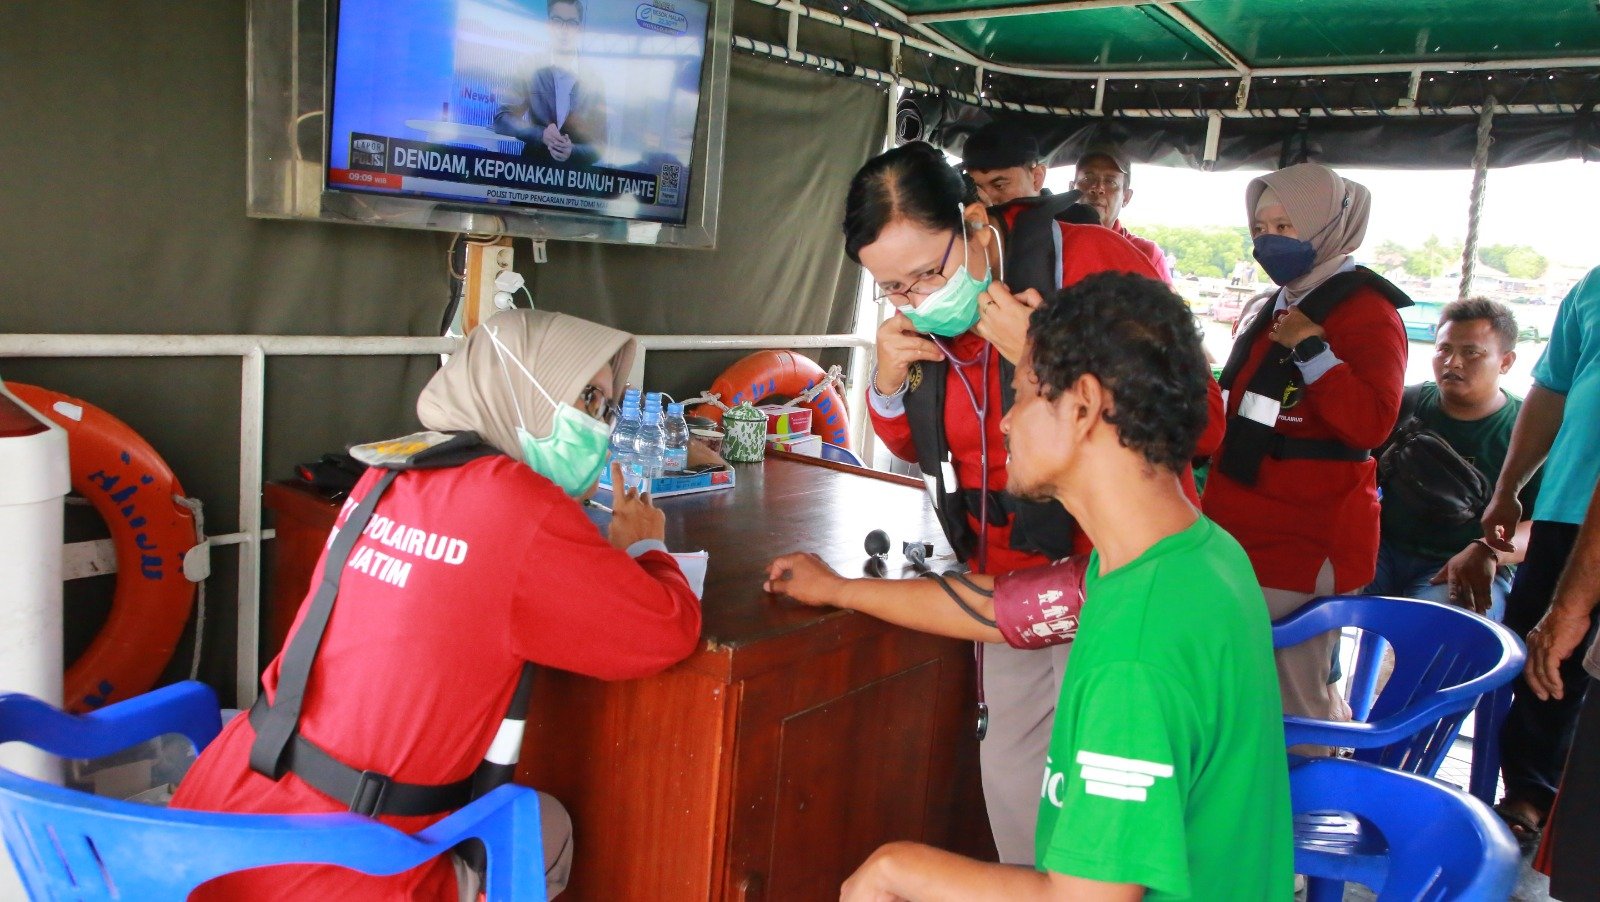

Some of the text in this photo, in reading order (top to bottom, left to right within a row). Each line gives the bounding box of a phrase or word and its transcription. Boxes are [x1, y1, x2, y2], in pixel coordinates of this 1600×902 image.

[356, 140, 382, 150] LAPOR
[352, 151, 384, 167] POLISI
[375, 176, 387, 184] WIB
[394, 146, 656, 198] DENDAM, KEPONAKAN BUNUH TANTE
[487, 189, 507, 199] POLISI
[509, 191, 529, 201] TUTUP
[530, 194, 565, 205] PENCARIAN
[348, 545, 412, 588] JATIM
